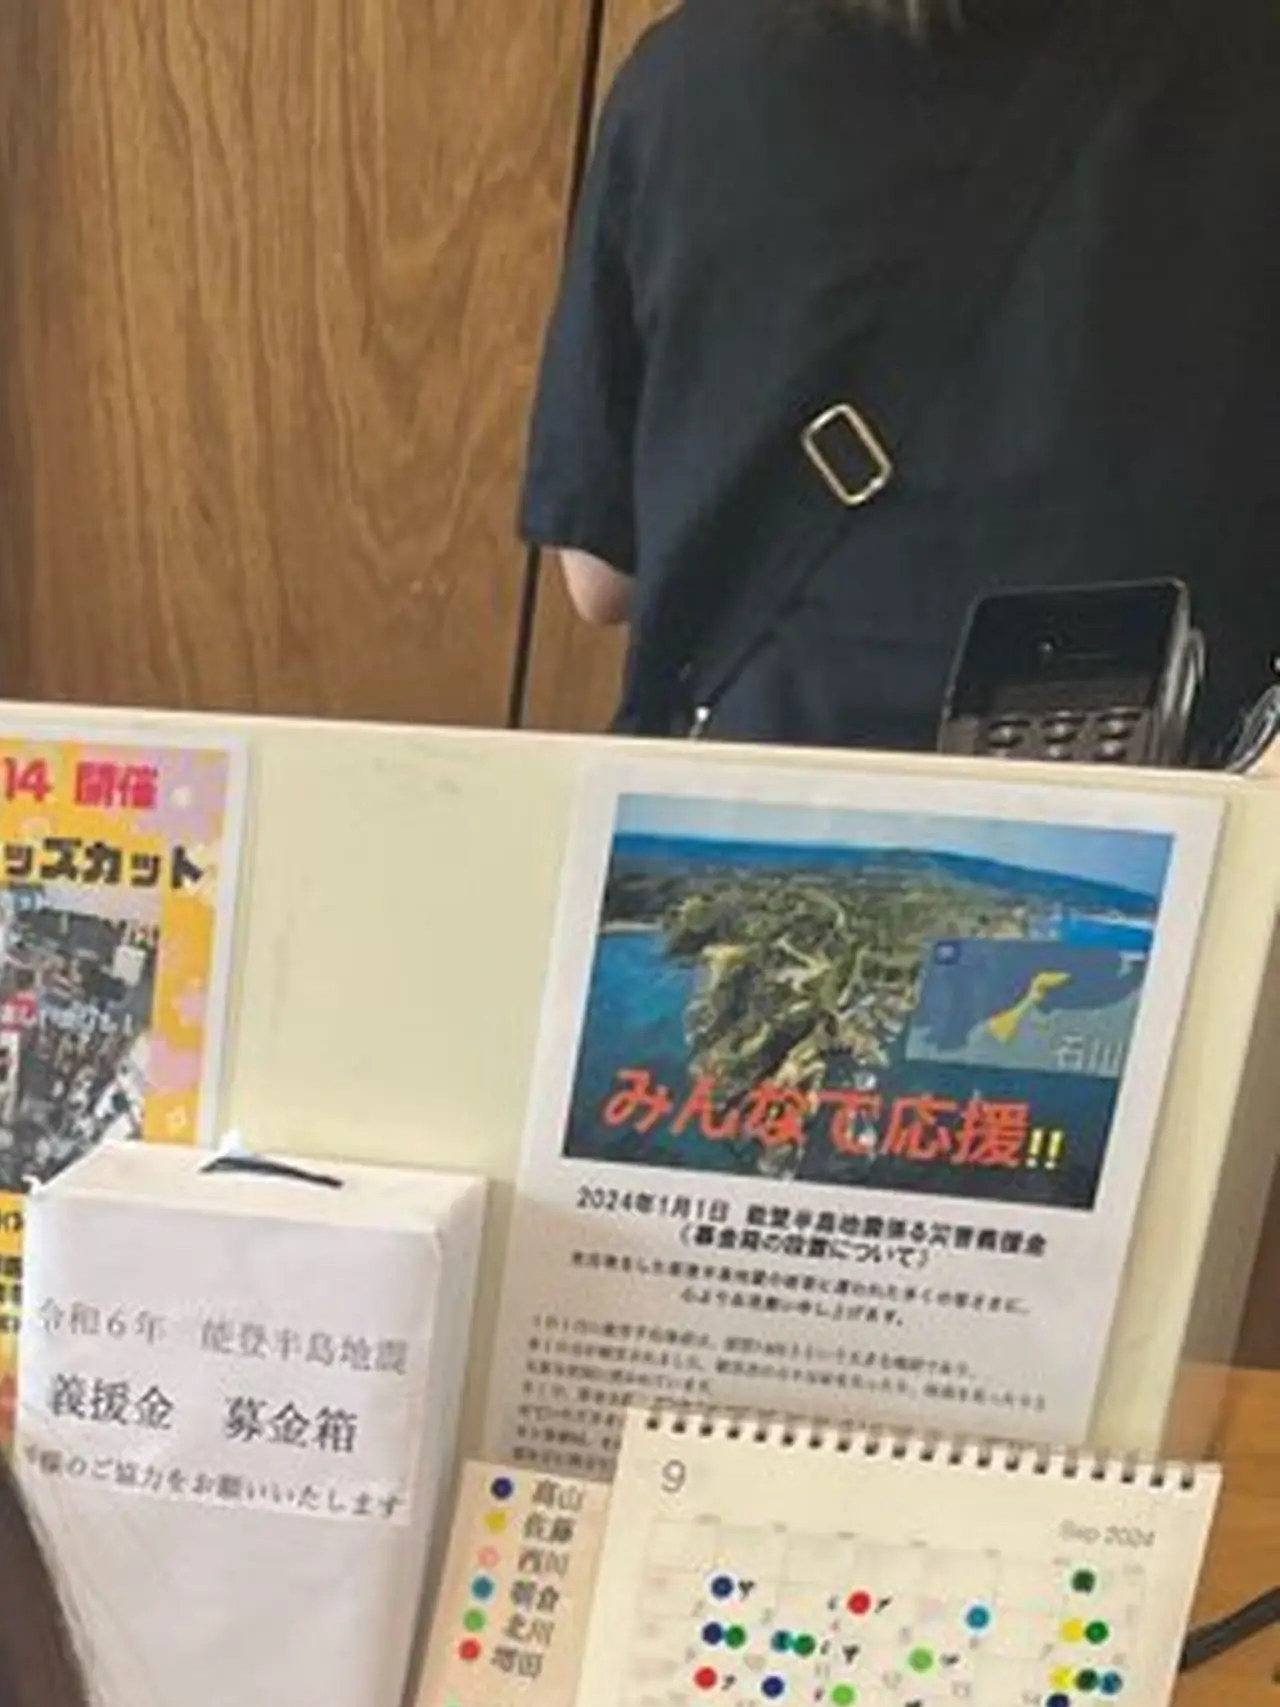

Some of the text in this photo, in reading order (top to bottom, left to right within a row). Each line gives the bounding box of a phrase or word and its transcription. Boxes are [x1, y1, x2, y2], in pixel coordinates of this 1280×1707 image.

[74, 761, 160, 812] 開催
[1056, 1033, 1124, 1079] 石川
[602, 1067, 1068, 1173] みんなで応援!!
[576, 1185, 730, 1223] 2024年1月1日
[201, 1317, 409, 1376] 能登半島地震
[49, 1371, 359, 1454] 義援金 募金箱
[532, 1480, 584, 1511] 高山
[660, 1459, 687, 1494] 9
[523, 1511, 575, 1544] 佐藤
[1059, 1518, 1102, 1545] Sep
